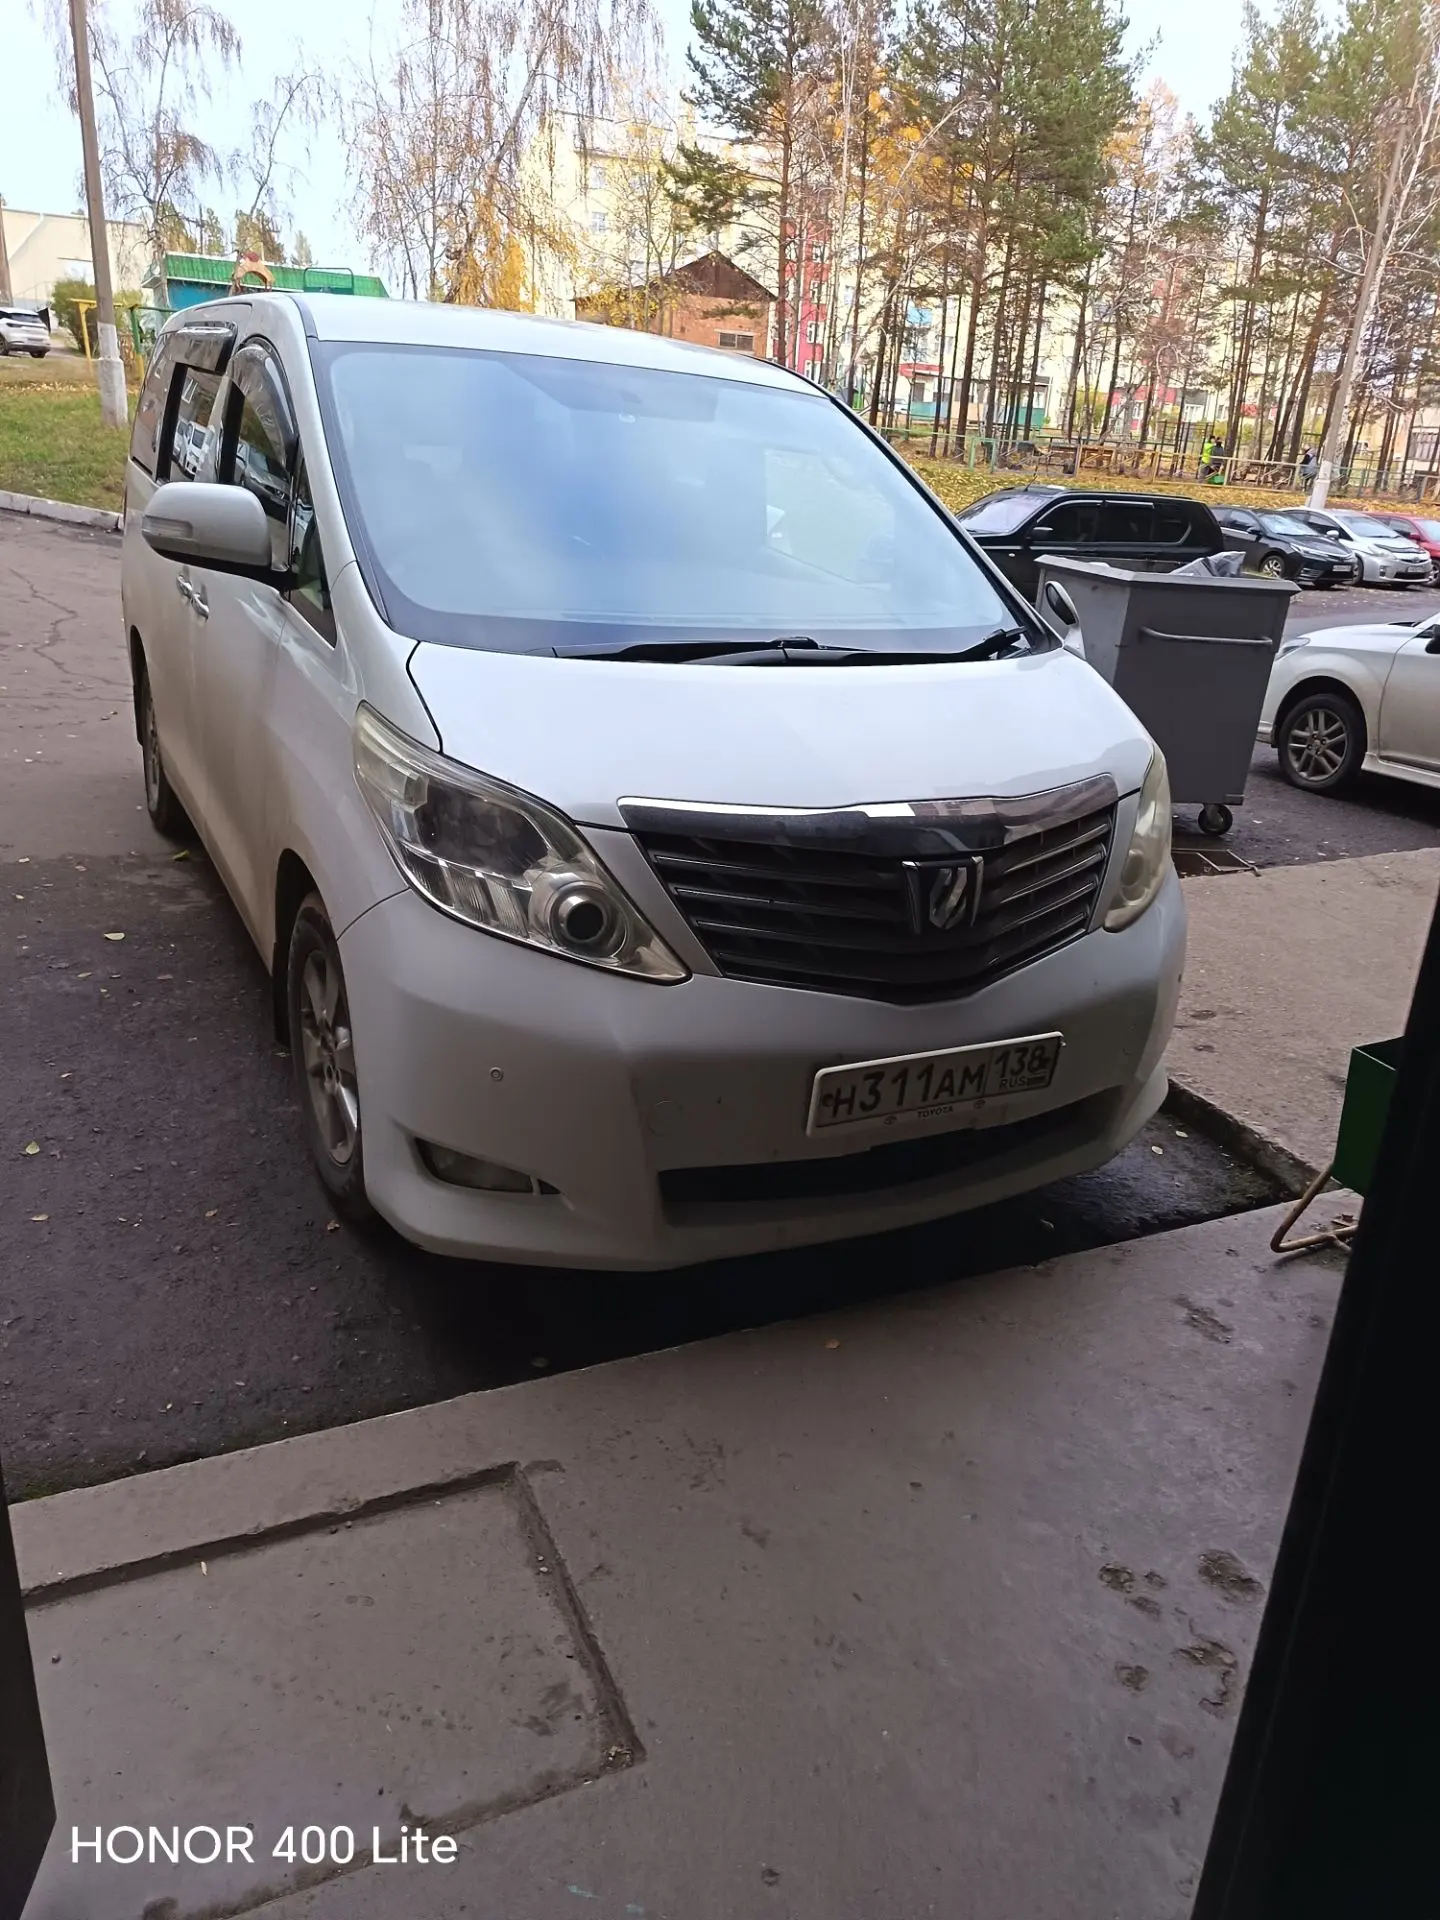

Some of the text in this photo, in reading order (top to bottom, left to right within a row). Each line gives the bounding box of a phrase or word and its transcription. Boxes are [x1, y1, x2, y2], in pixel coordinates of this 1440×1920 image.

[995, 1045, 1047, 1079] 138
[998, 1076, 1027, 1090] RUS
[917, 1106, 954, 1119] TOYOTA
